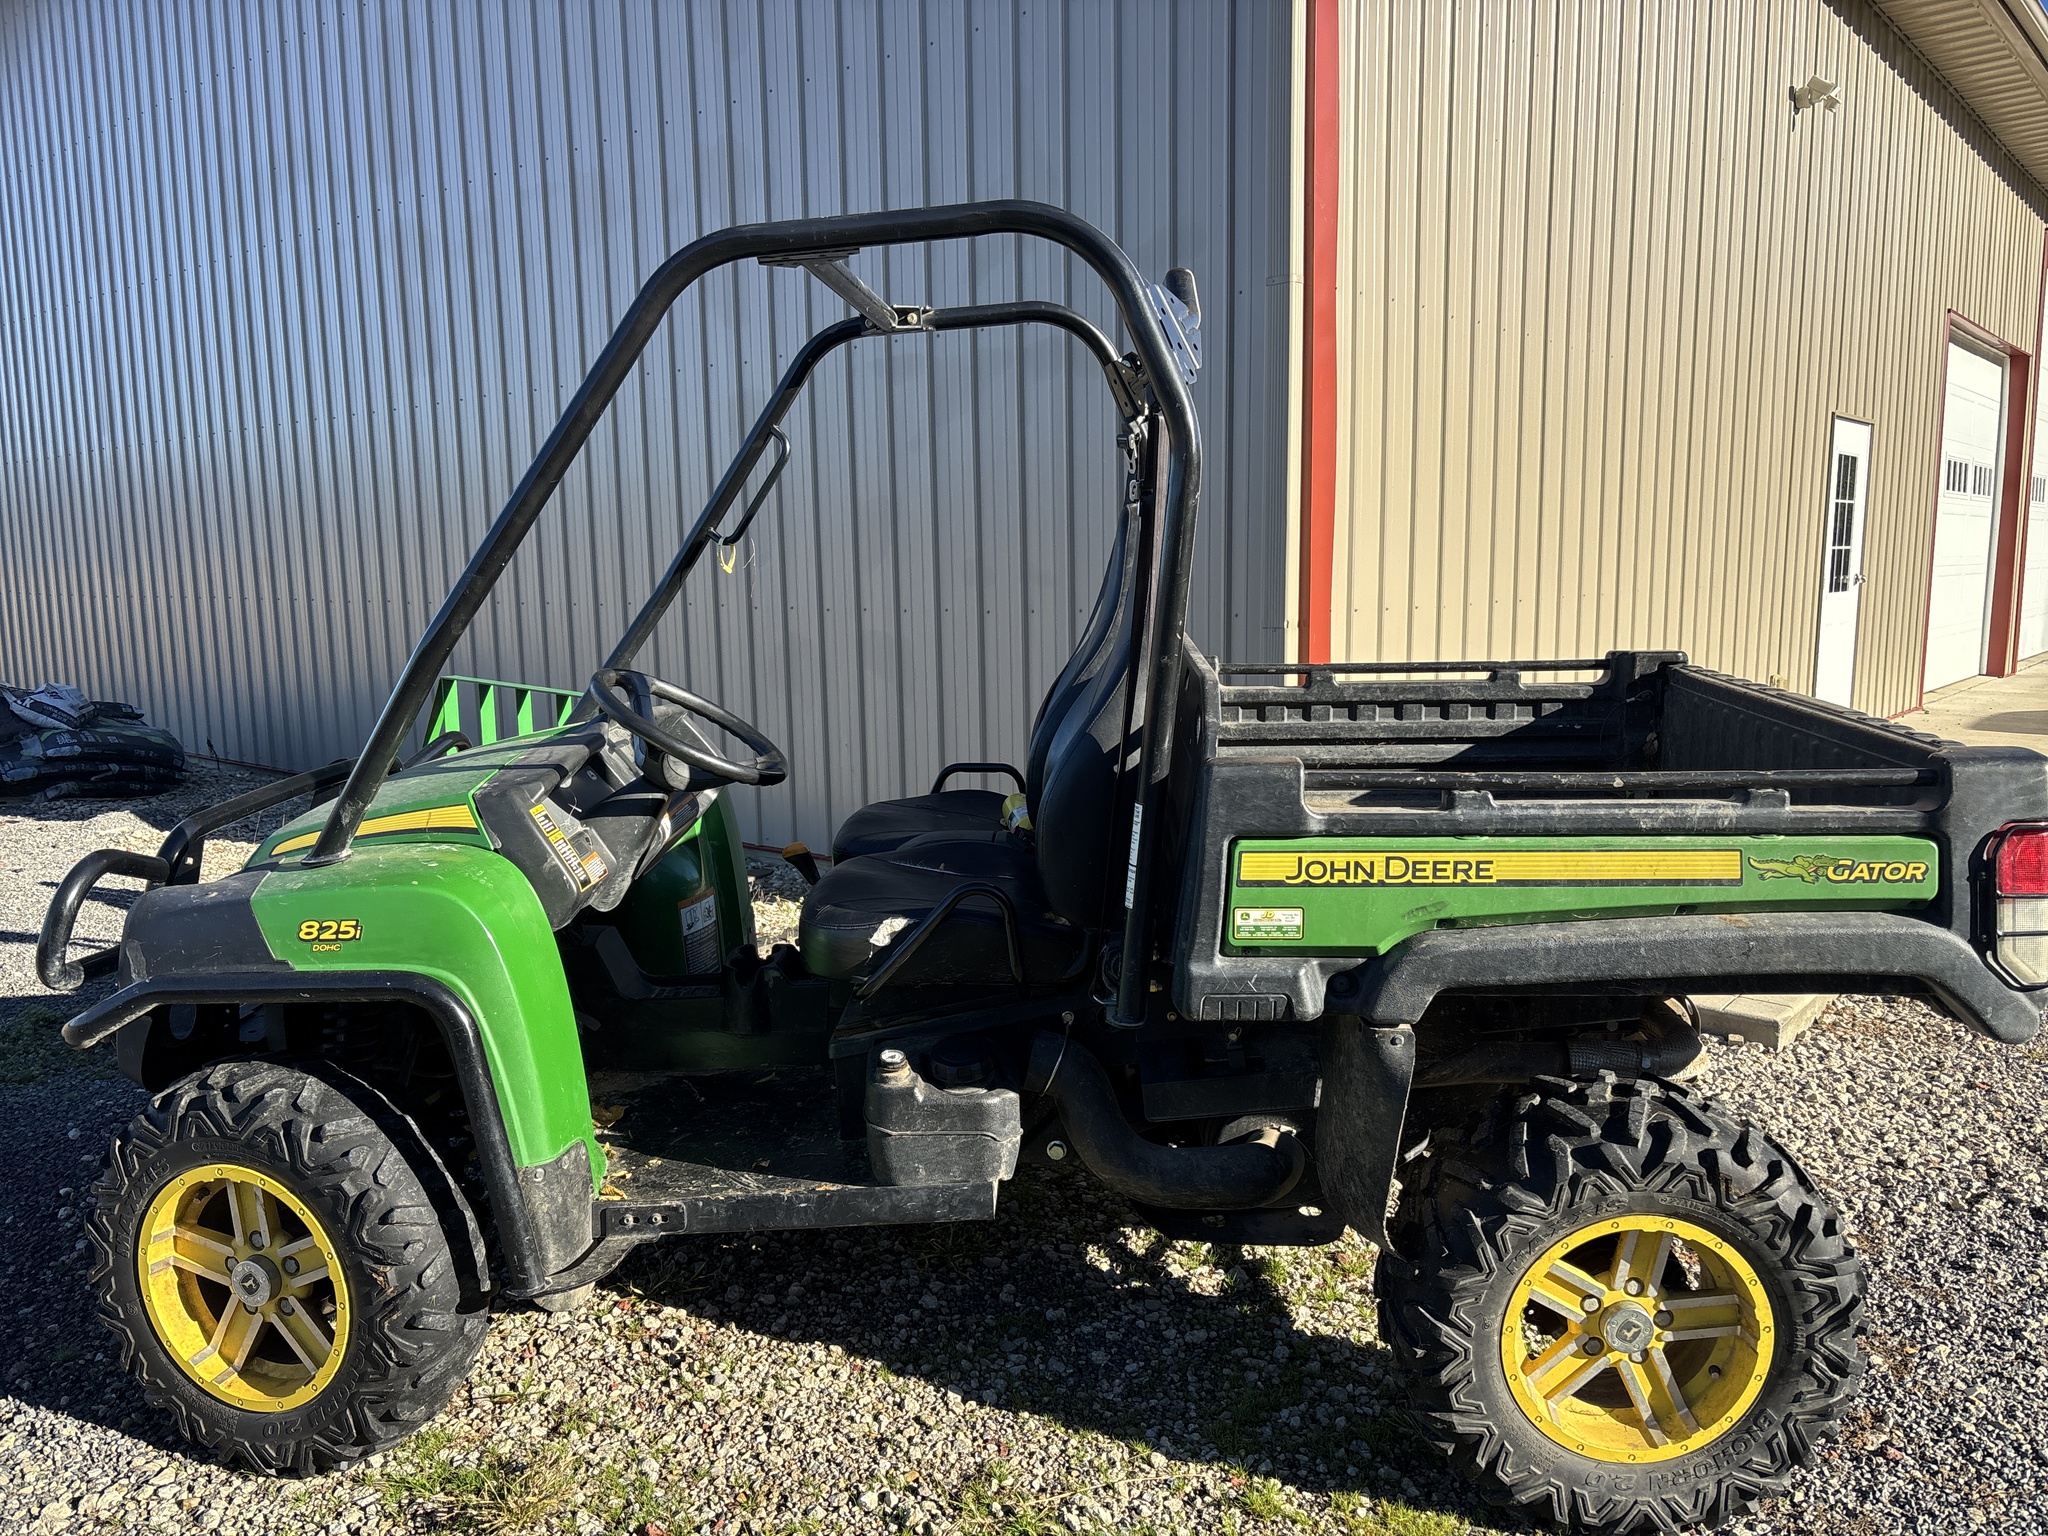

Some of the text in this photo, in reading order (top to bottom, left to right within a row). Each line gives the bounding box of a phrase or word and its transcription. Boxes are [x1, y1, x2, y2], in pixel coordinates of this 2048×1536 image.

[1285, 856, 1494, 881] JOHN DEERE
[1826, 859, 1928, 883] GATOR
[298, 920, 362, 941] 825i
[312, 943, 341, 952] DOHC
[1649, 1408, 1778, 1491] BIGHORN
